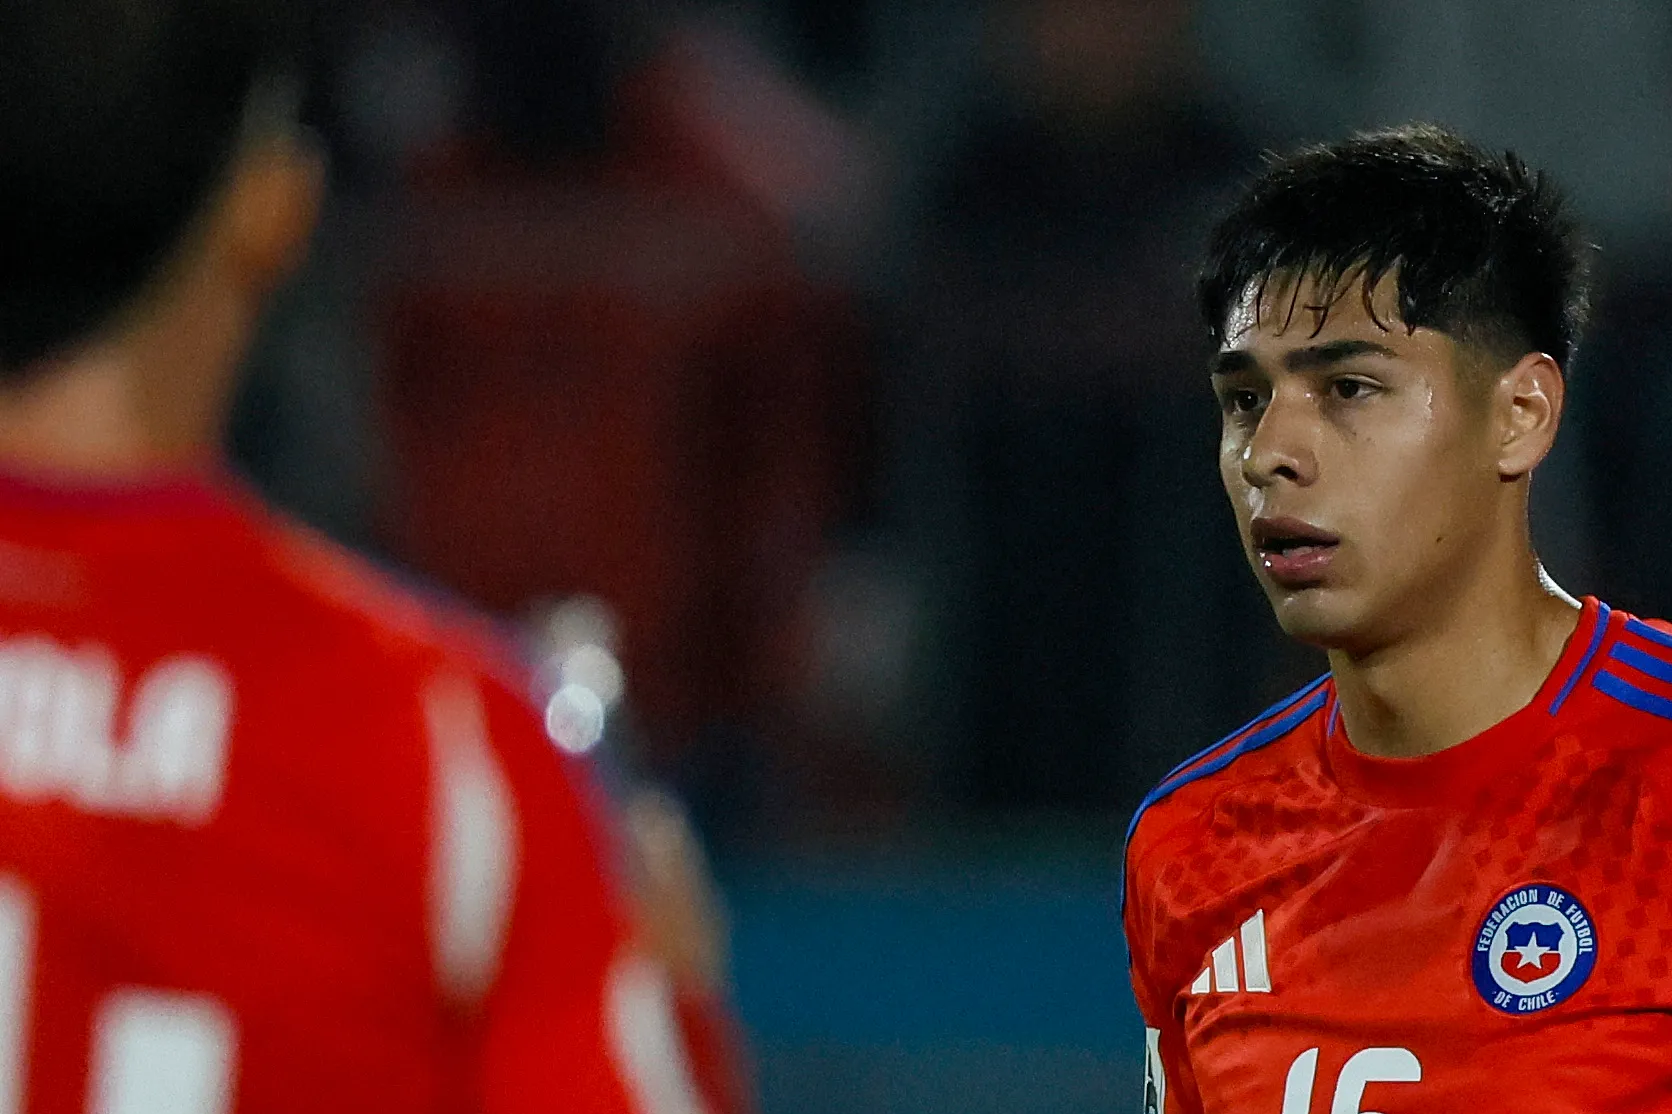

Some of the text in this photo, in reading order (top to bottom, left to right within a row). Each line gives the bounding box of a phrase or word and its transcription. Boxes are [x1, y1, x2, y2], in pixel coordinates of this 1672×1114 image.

[1477, 888, 1593, 955] FEDERACION DE FUTBOL
[1493, 990, 1556, 1011] DE CHILE
